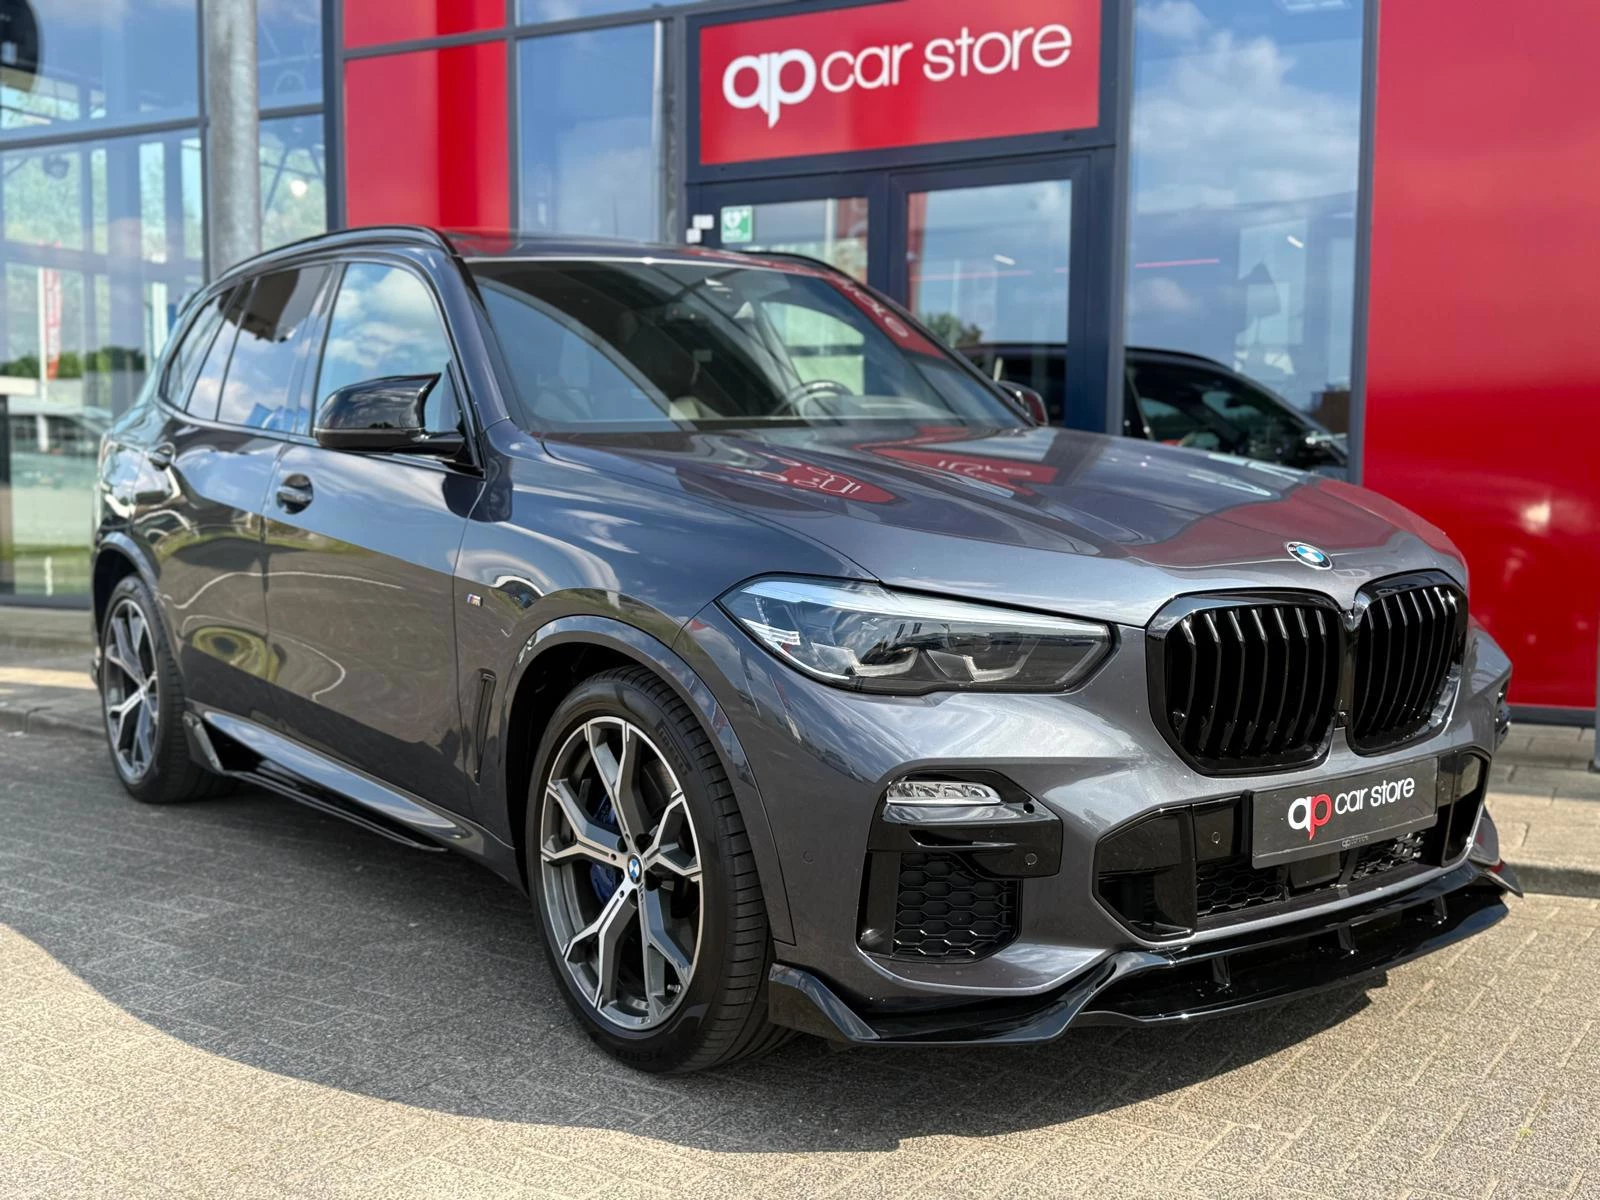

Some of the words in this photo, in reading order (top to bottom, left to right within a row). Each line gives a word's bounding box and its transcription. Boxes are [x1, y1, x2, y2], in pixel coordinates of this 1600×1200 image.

[820, 42, 913, 93] car
[922, 23, 1072, 82] store
[1334, 788, 1369, 815] car
[1370, 777, 1415, 807] store
